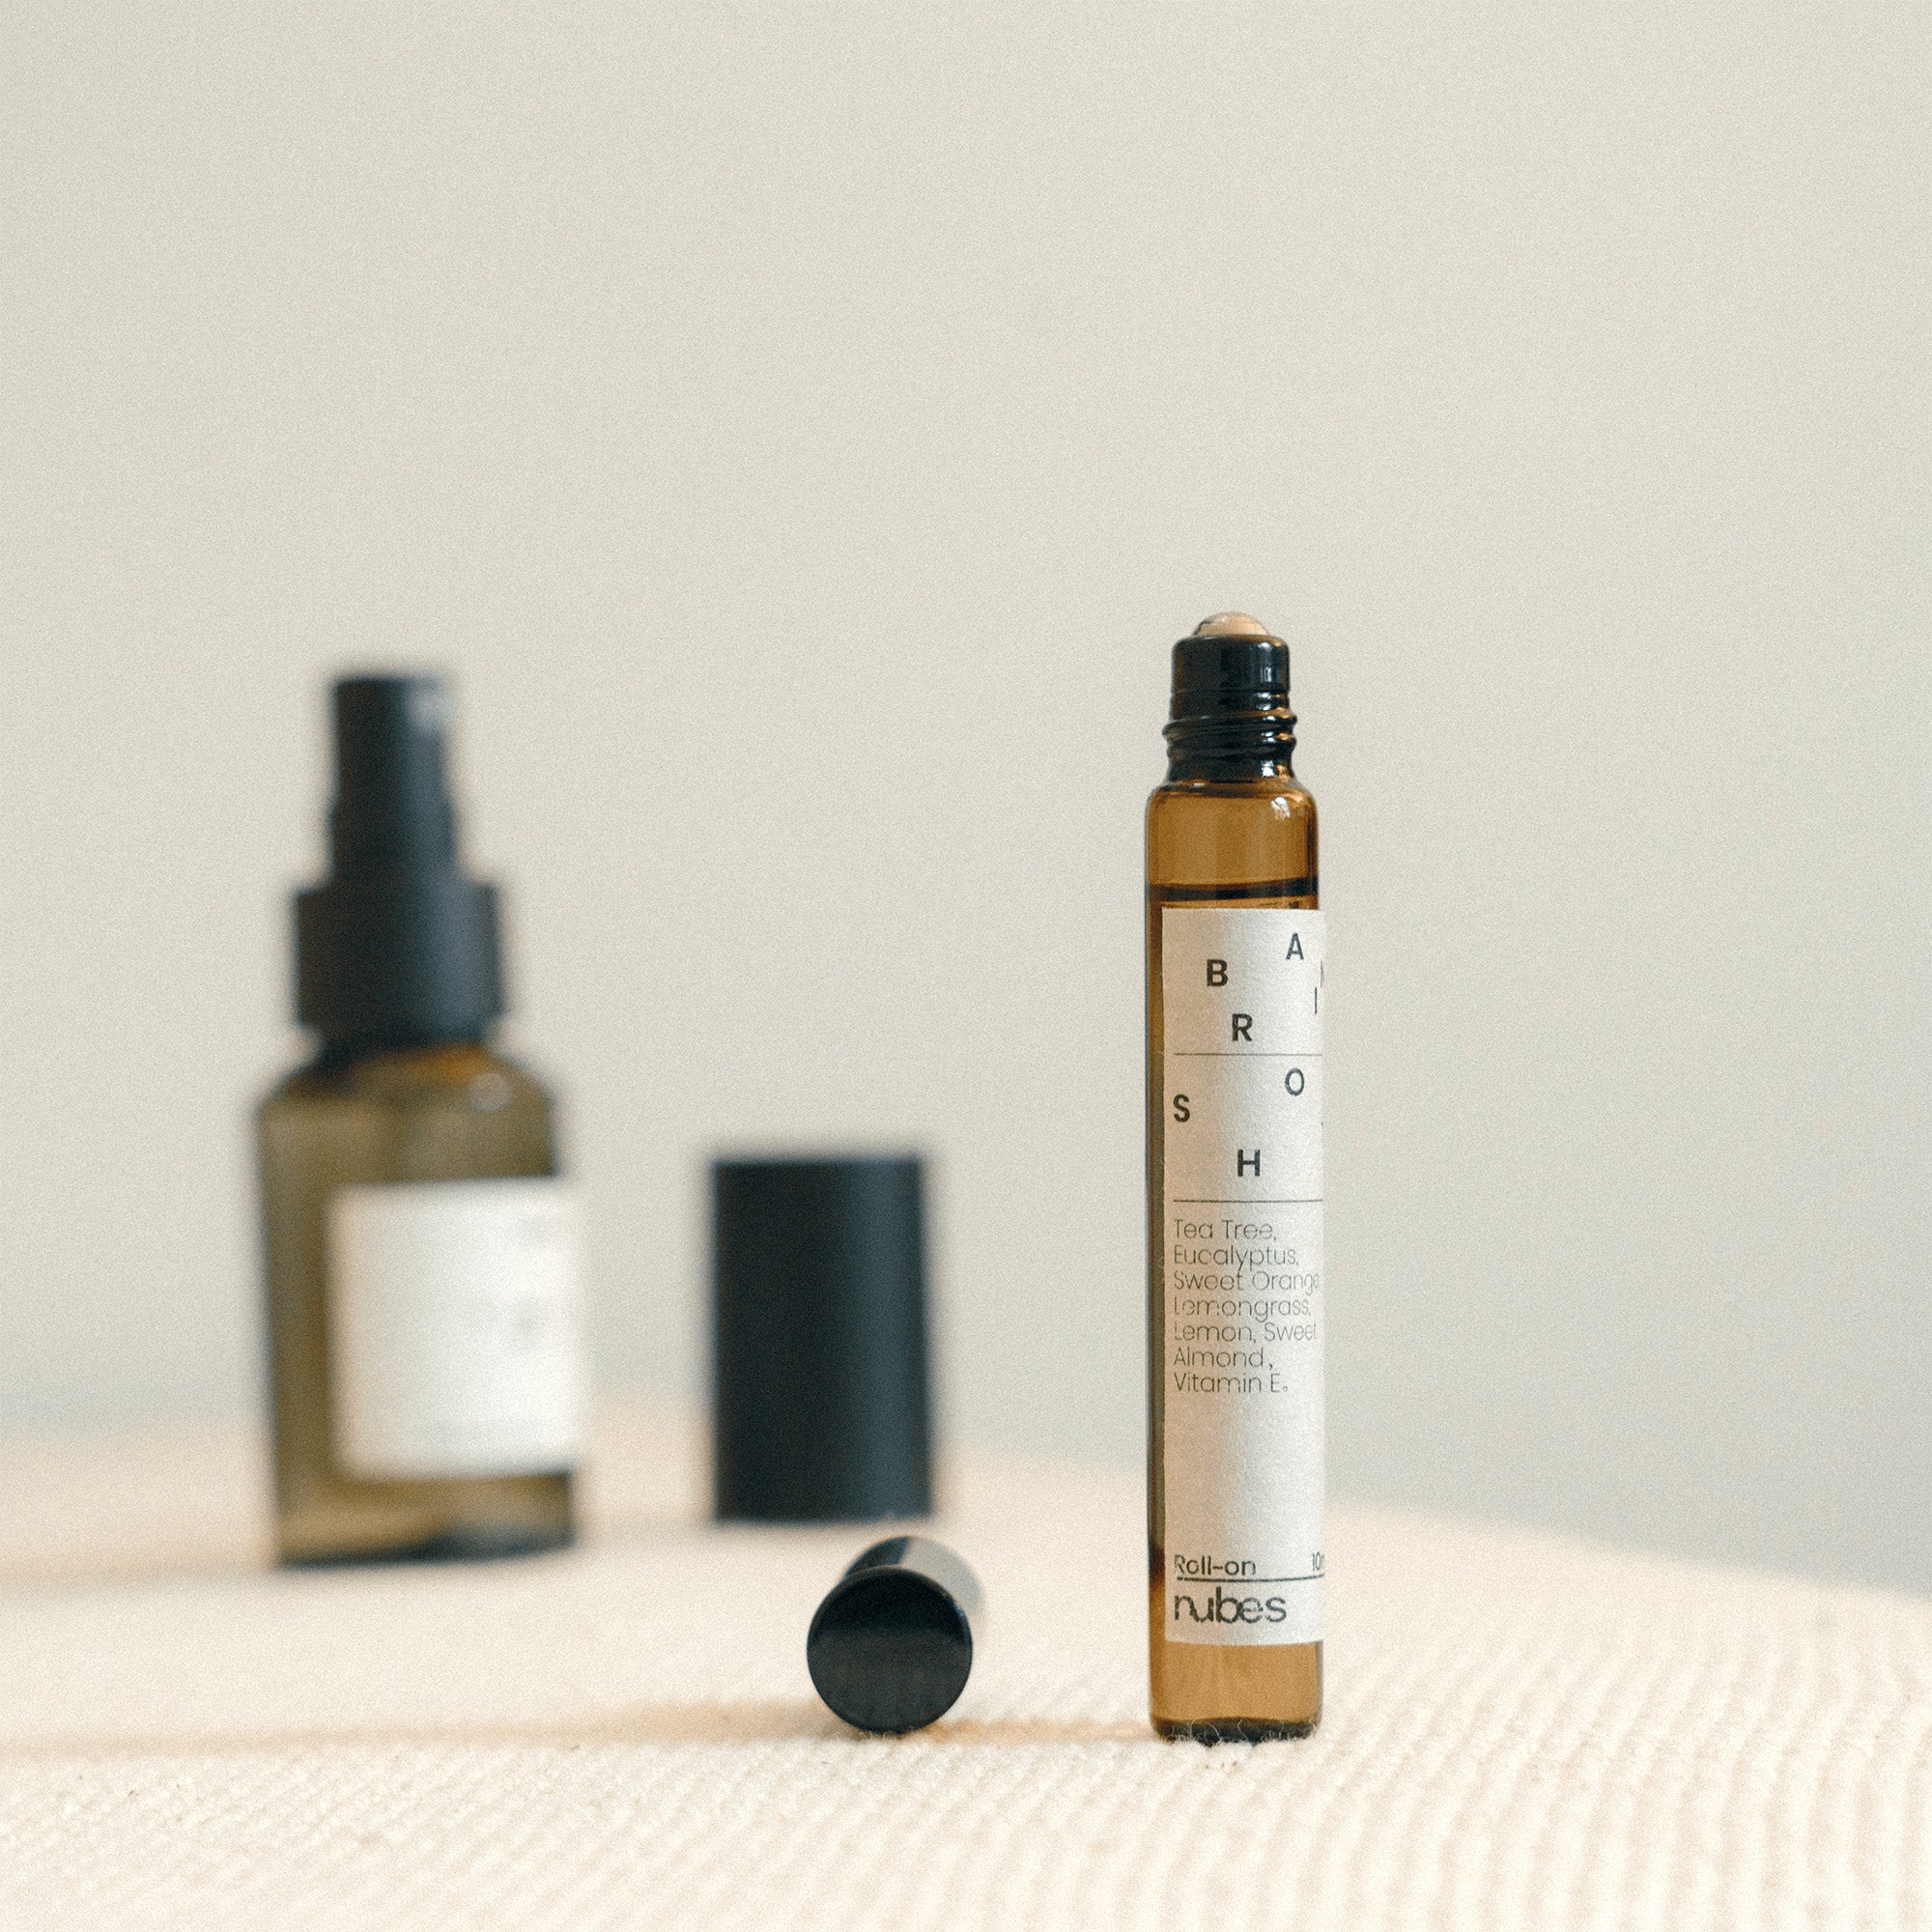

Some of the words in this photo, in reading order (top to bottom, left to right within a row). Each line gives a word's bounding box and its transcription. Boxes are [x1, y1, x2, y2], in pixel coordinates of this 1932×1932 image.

[1286, 932, 1304, 960] A
[1207, 959, 1229, 986] B
[1232, 1013, 1253, 1041] R
[1284, 1067, 1305, 1096] O
[1172, 1094, 1191, 1122] S
[1236, 1149, 1261, 1177] H
[1174, 1219, 1213, 1239] Tea
[1221, 1219, 1277, 1241] Tree,
[1174, 1244, 1299, 1271] Eucalyptus,
[1174, 1269, 1245, 1291] Sweet
[1174, 1295, 1312, 1323] Lemongrass,
[1174, 1321, 1257, 1344] Lemon,
[1264, 1321, 1318, 1342] Sweet
[1174, 1372, 1262, 1393] Vitamin
[1174, 1554, 1256, 1577] Roll-on
[1174, 1586, 1287, 1624] nubes
